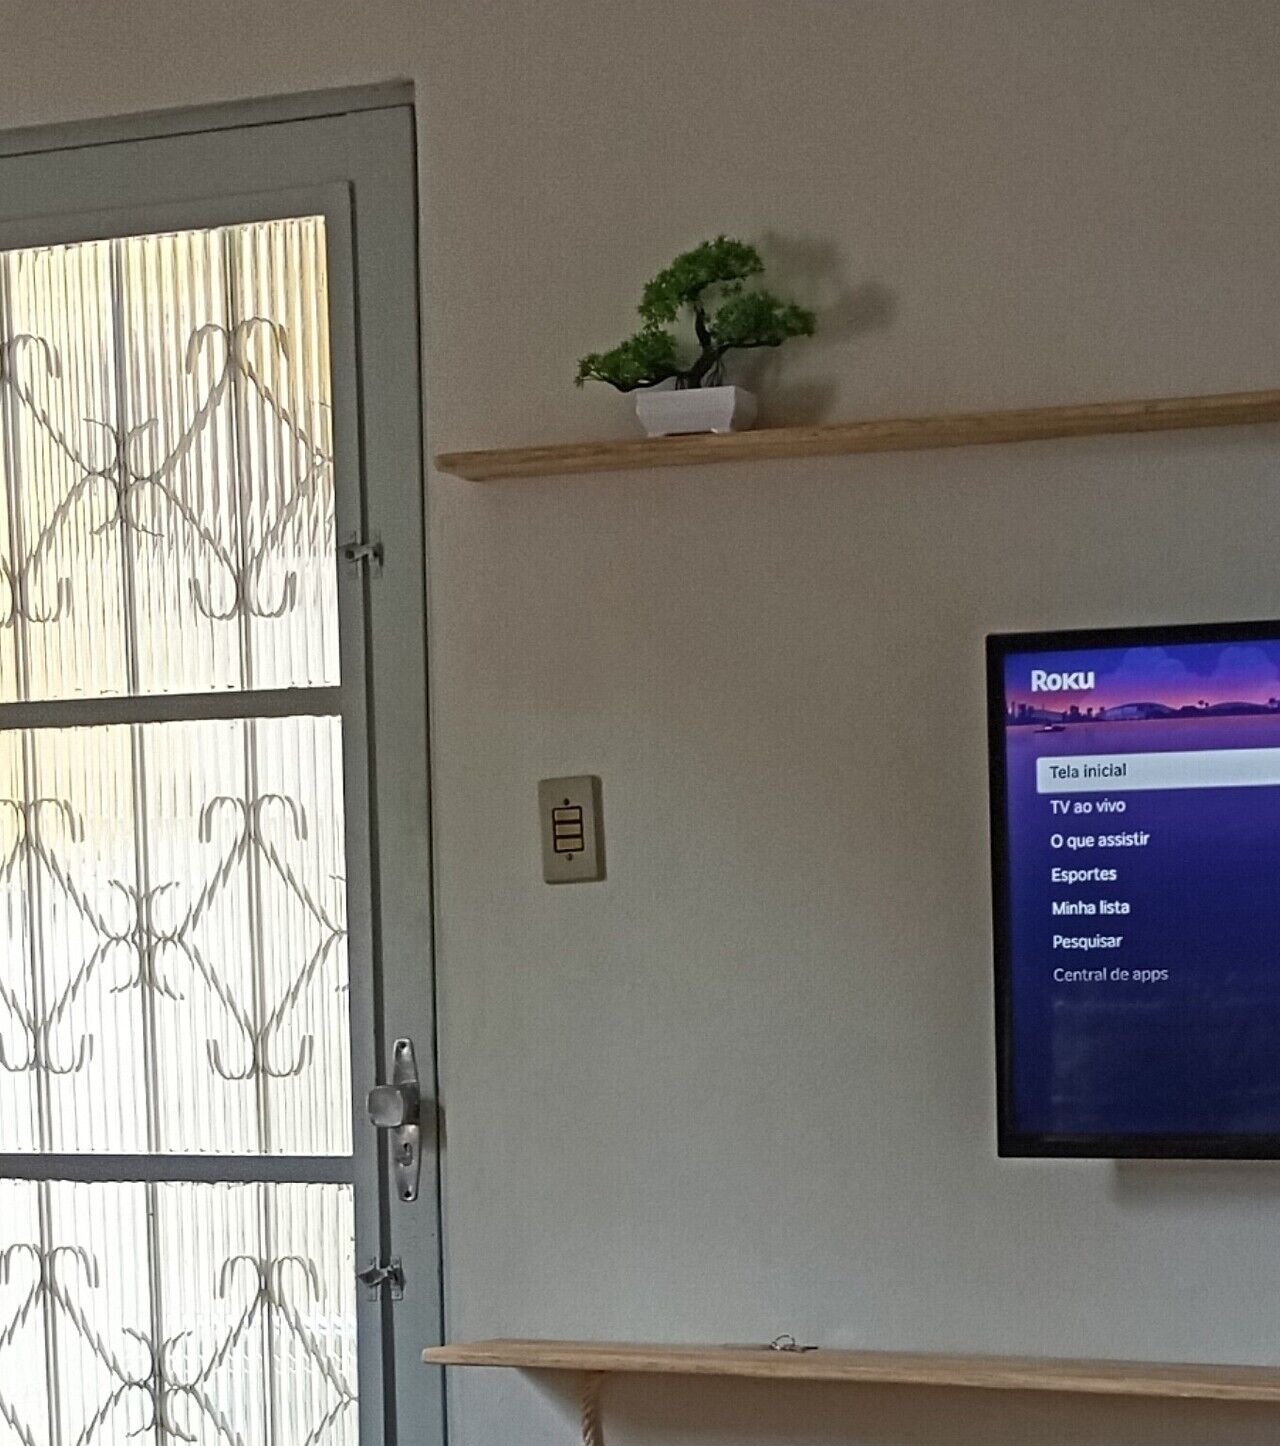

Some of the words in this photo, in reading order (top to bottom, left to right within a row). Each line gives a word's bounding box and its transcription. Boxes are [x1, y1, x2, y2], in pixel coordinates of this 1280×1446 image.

[1049, 765, 1079, 779] Tela
[1084, 763, 1127, 778] inicial
[1050, 800, 1070, 814] TV
[1073, 801, 1093, 813] ao
[1096, 798, 1126, 812] vivo
[1050, 834, 1063, 848] O
[1067, 834, 1094, 850] que
[1098, 831, 1150, 846] assistir
[1051, 867, 1117, 884] Esportes
[1052, 901, 1096, 915] Minha
[1100, 900, 1130, 914] lista
[1053, 934, 1123, 950] Pesquisar
[1053, 968, 1107, 982] Central
[1110, 967, 1129, 981] de
[1132, 969, 1169, 983] apps
